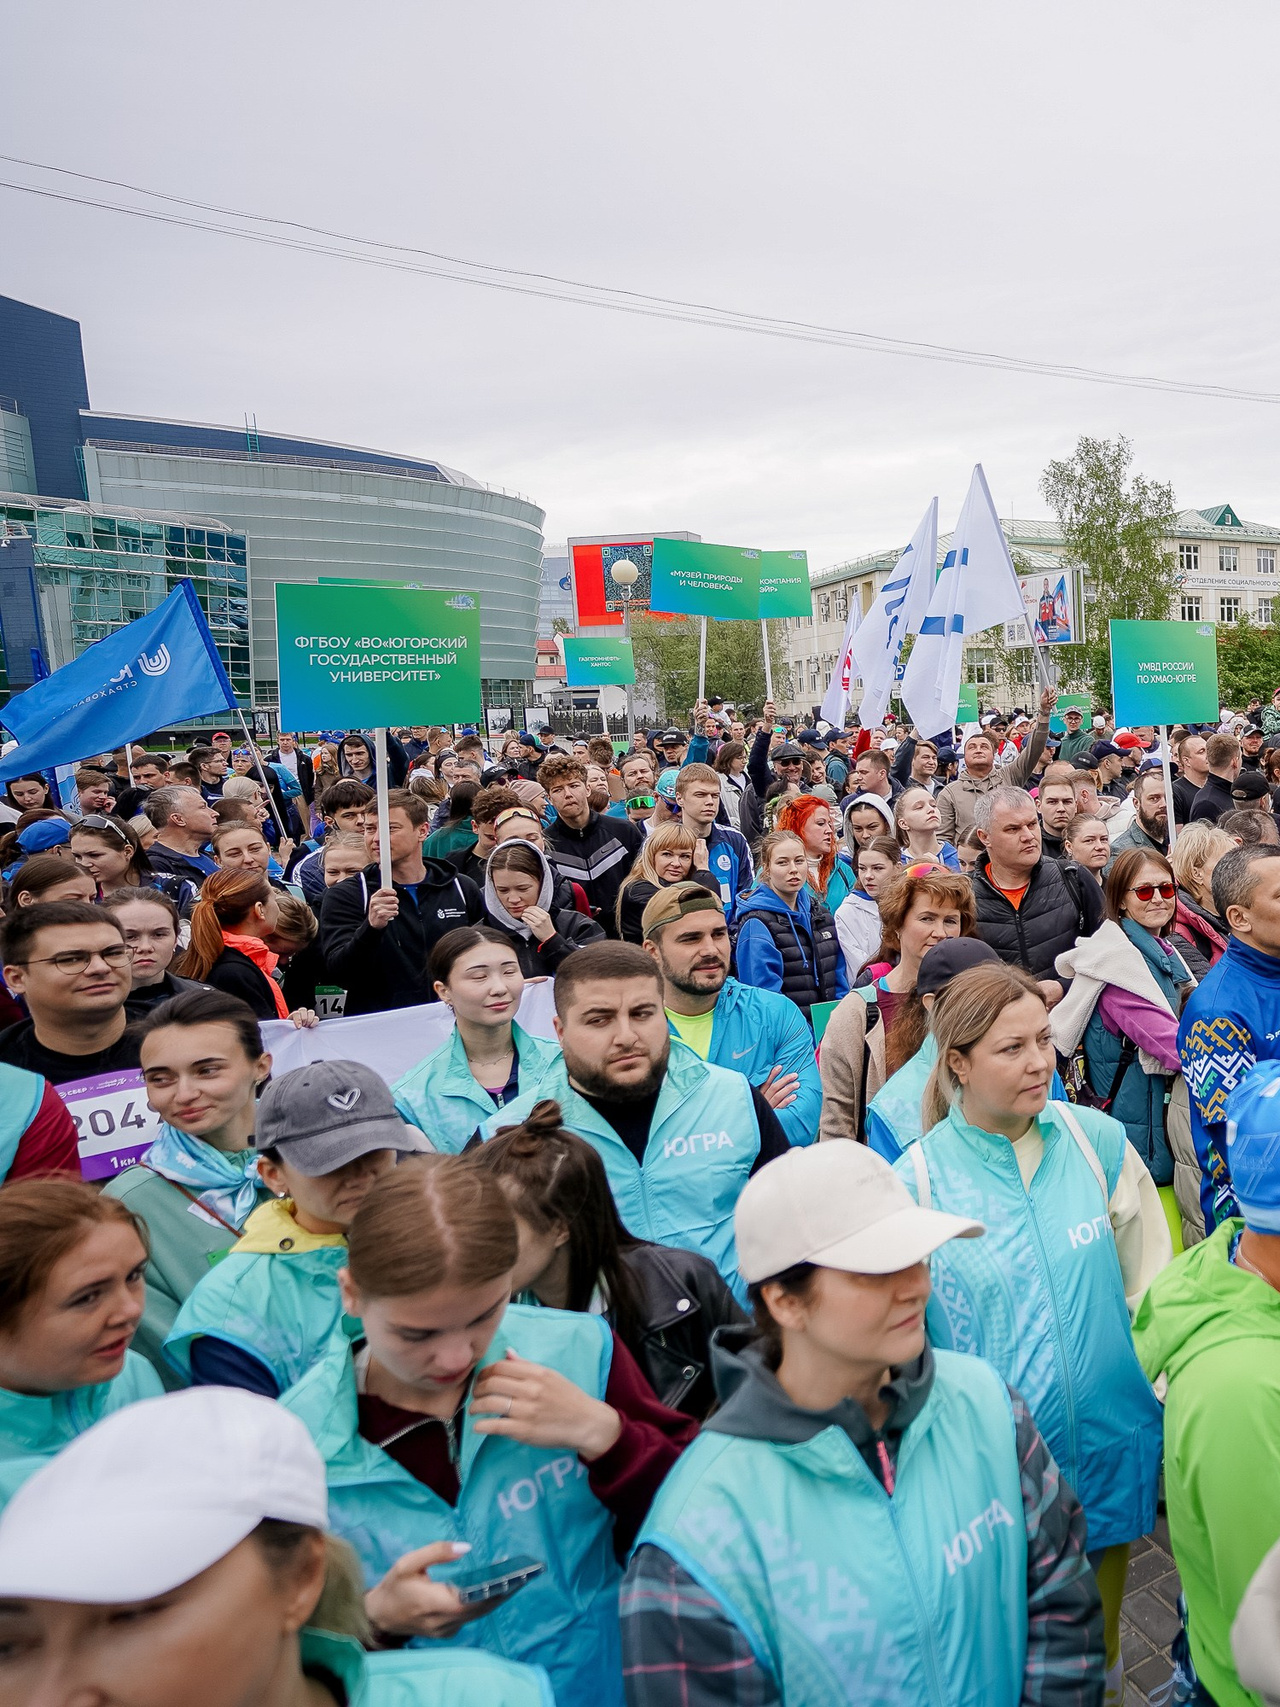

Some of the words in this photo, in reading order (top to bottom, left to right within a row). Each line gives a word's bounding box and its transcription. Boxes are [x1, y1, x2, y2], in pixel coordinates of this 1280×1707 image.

[670, 570, 702, 579] «МУЗЕЙ
[703, 573, 743, 583] ПРИРОДЫ
[1191, 577, 1227, 586] ОТДЕЛЕНИЕ
[1228, 579, 1271, 587] СОЦИАЛЬНОГО
[688, 581, 733, 591] ЧЕЛОВЕКА»
[295, 636, 351, 649] ФГБОУ
[354, 636, 468, 649] «ВО«ЮГОРСКИЙ
[309, 652, 457, 667] ГОСУДАРСТВЕННЫЙ
[1138, 662, 1161, 672] УМВД
[1162, 662, 1194, 671] РОССИИ
[329, 670, 441, 683] УНИВЕРСИТЕТ»
[1137, 675, 1149, 684] ПО
[1150, 674, 1197, 684] ХМАО-ЮГРЕ
[70, 1101, 163, 1142] 204
[663, 1131, 734, 1159] ЮГРА
[110, 1156, 118, 1169] 1
[943, 1499, 1015, 1576] ЮГРА
